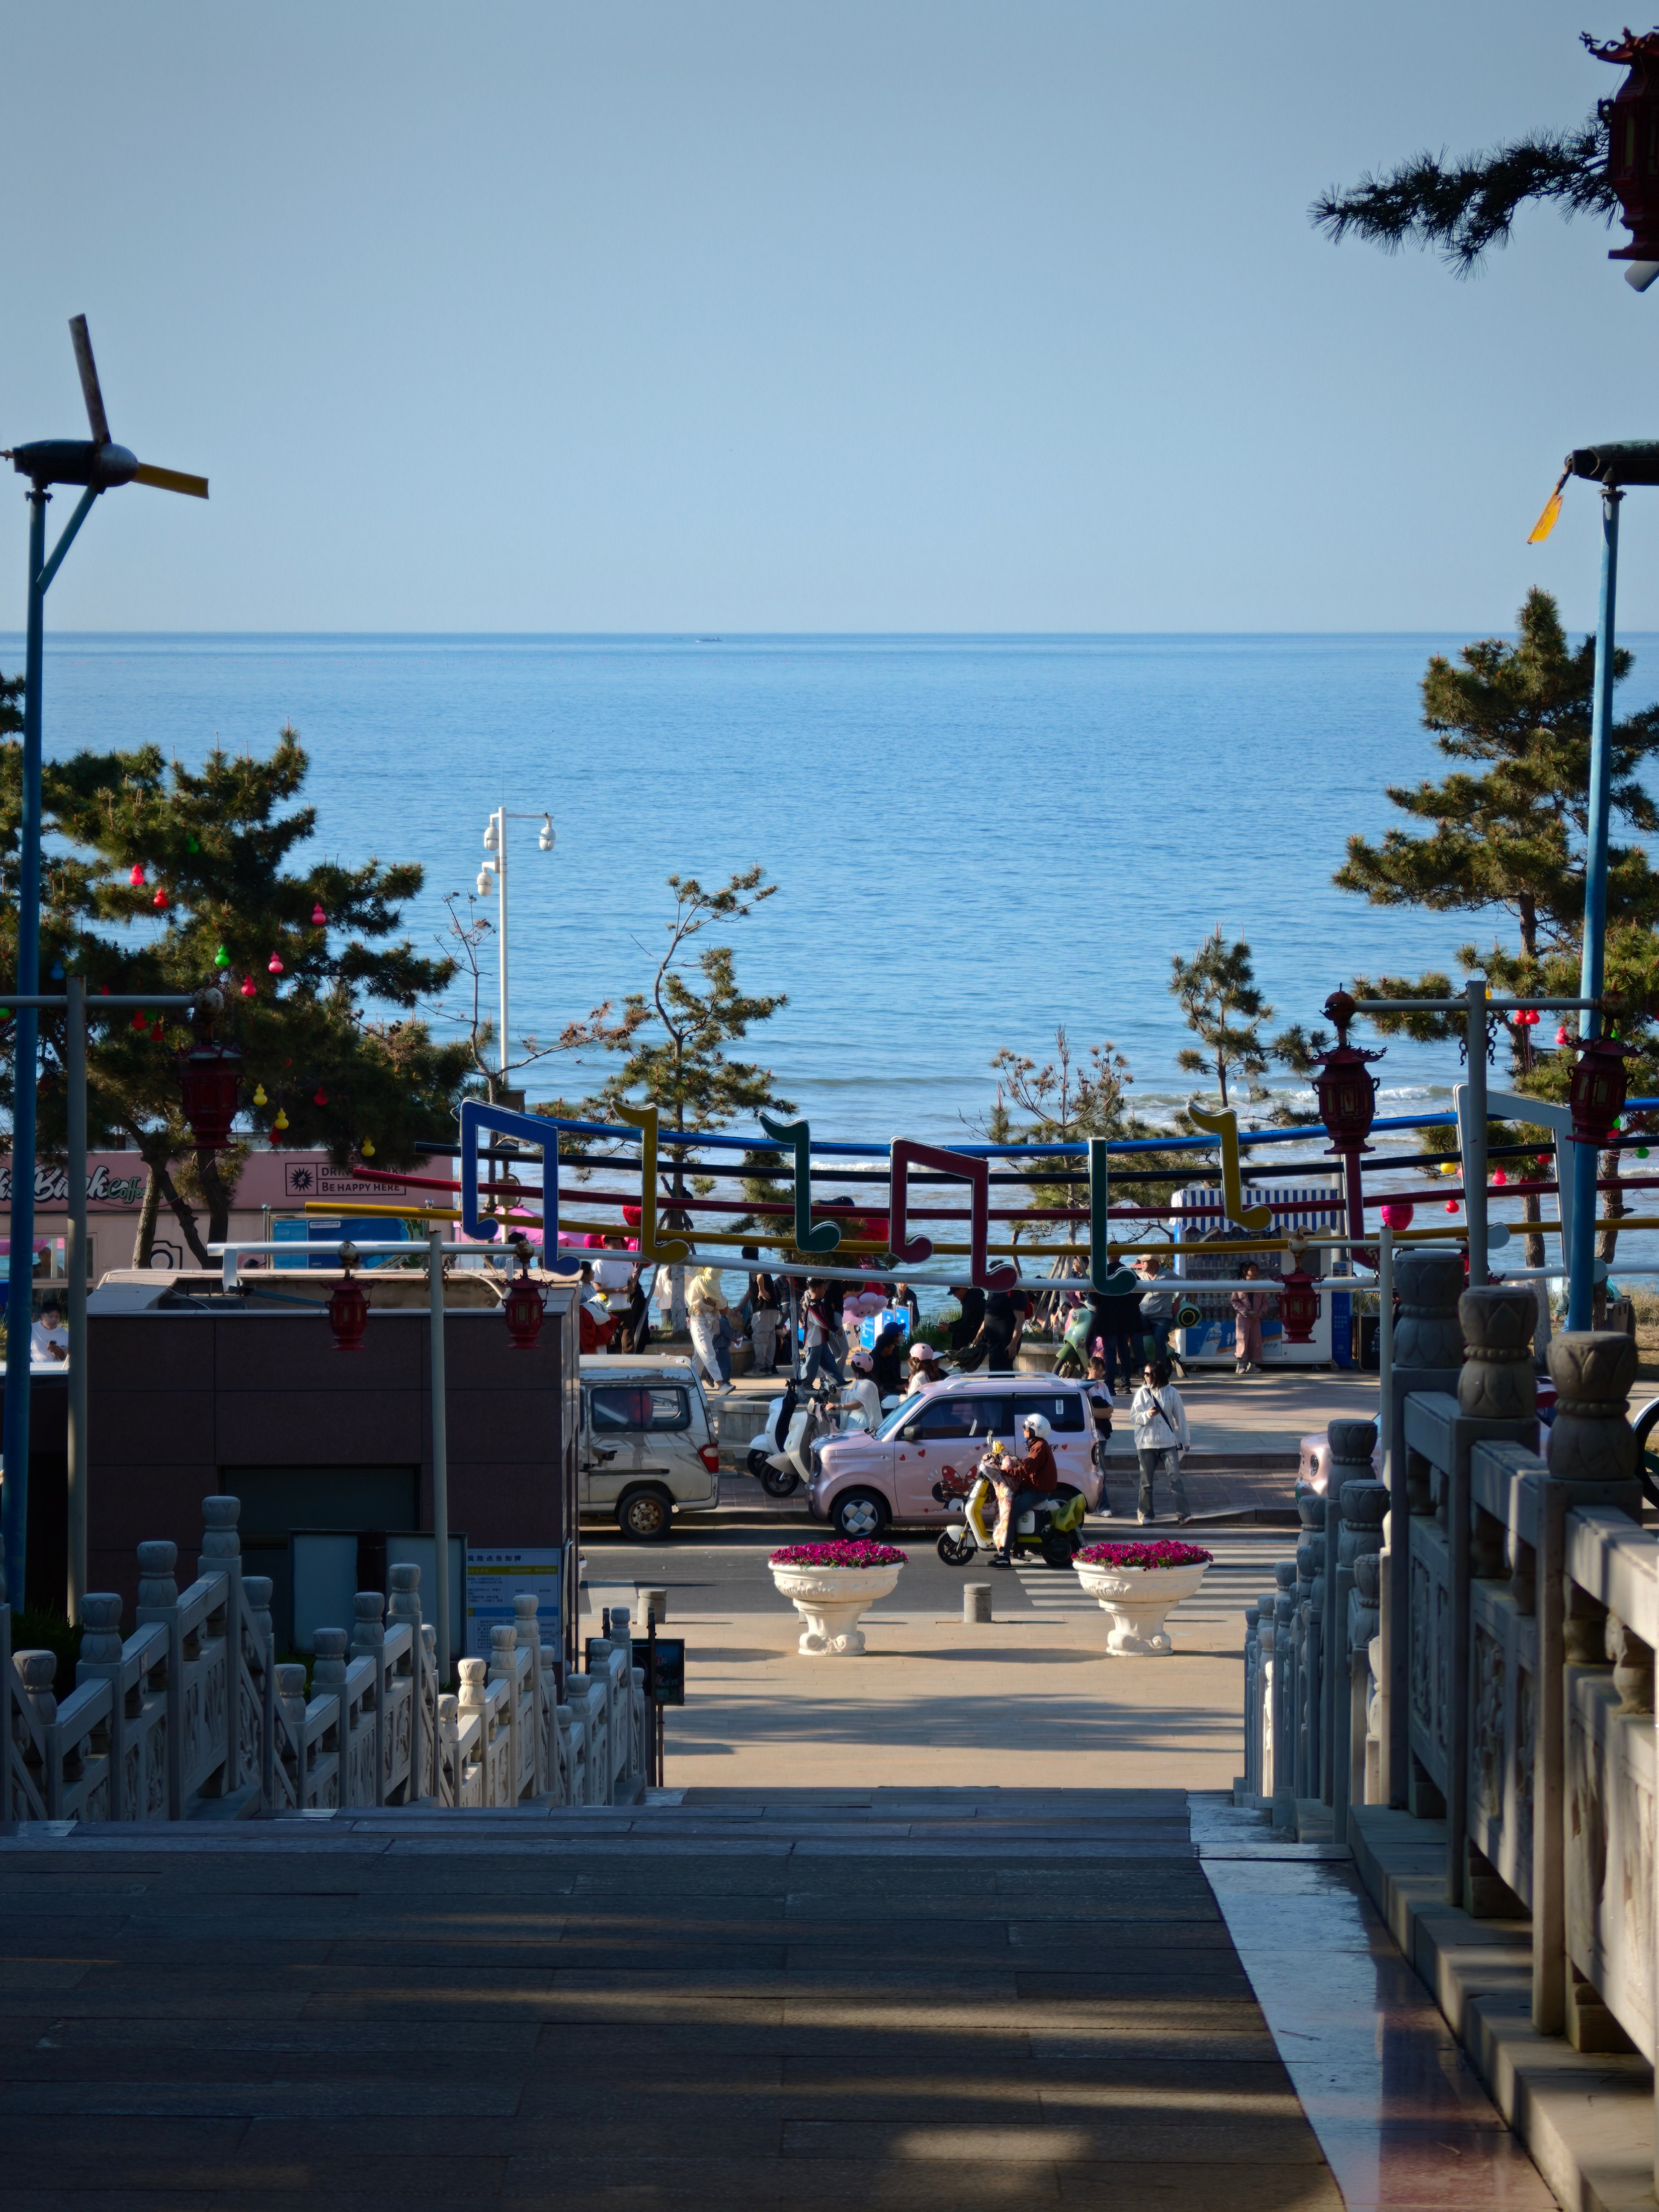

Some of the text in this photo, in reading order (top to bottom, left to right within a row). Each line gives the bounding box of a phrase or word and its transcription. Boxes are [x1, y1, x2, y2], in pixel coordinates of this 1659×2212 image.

[107, 1176, 164, 1204] Coffe
[322, 1182, 400, 1191] BE HAPPY HERE
